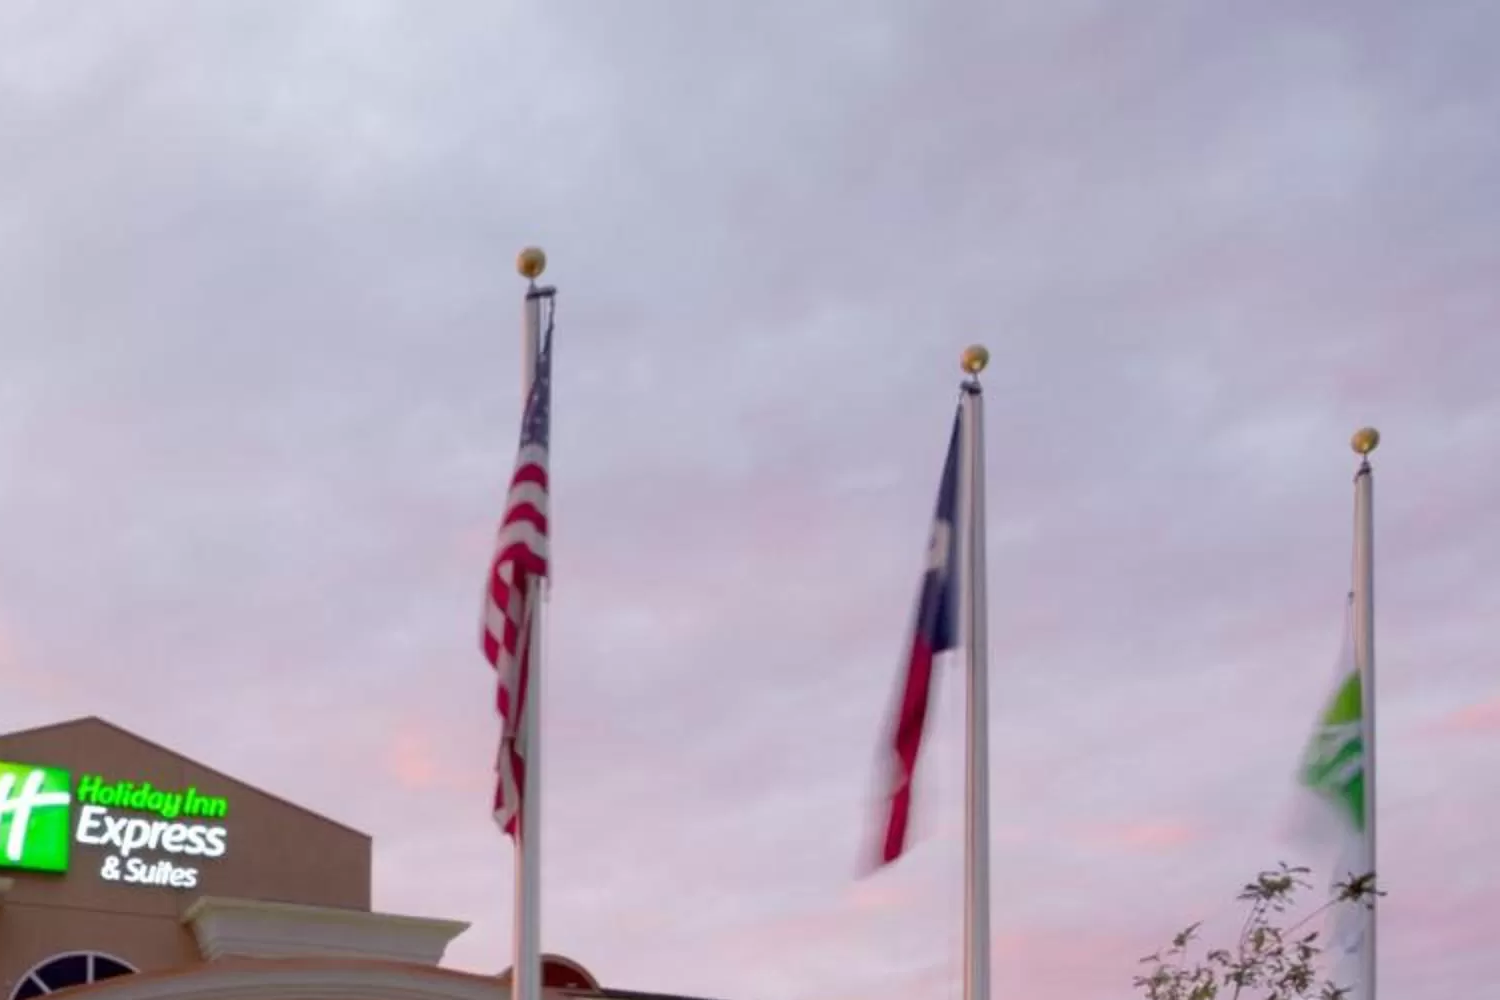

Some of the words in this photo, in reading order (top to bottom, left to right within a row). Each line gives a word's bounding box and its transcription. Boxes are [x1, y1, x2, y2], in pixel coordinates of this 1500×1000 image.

[77, 775, 182, 817] Holiday
[184, 788, 227, 816] Inn
[76, 805, 227, 857] Express
[101, 857, 120, 880] &
[124, 860, 198, 887] Suites
